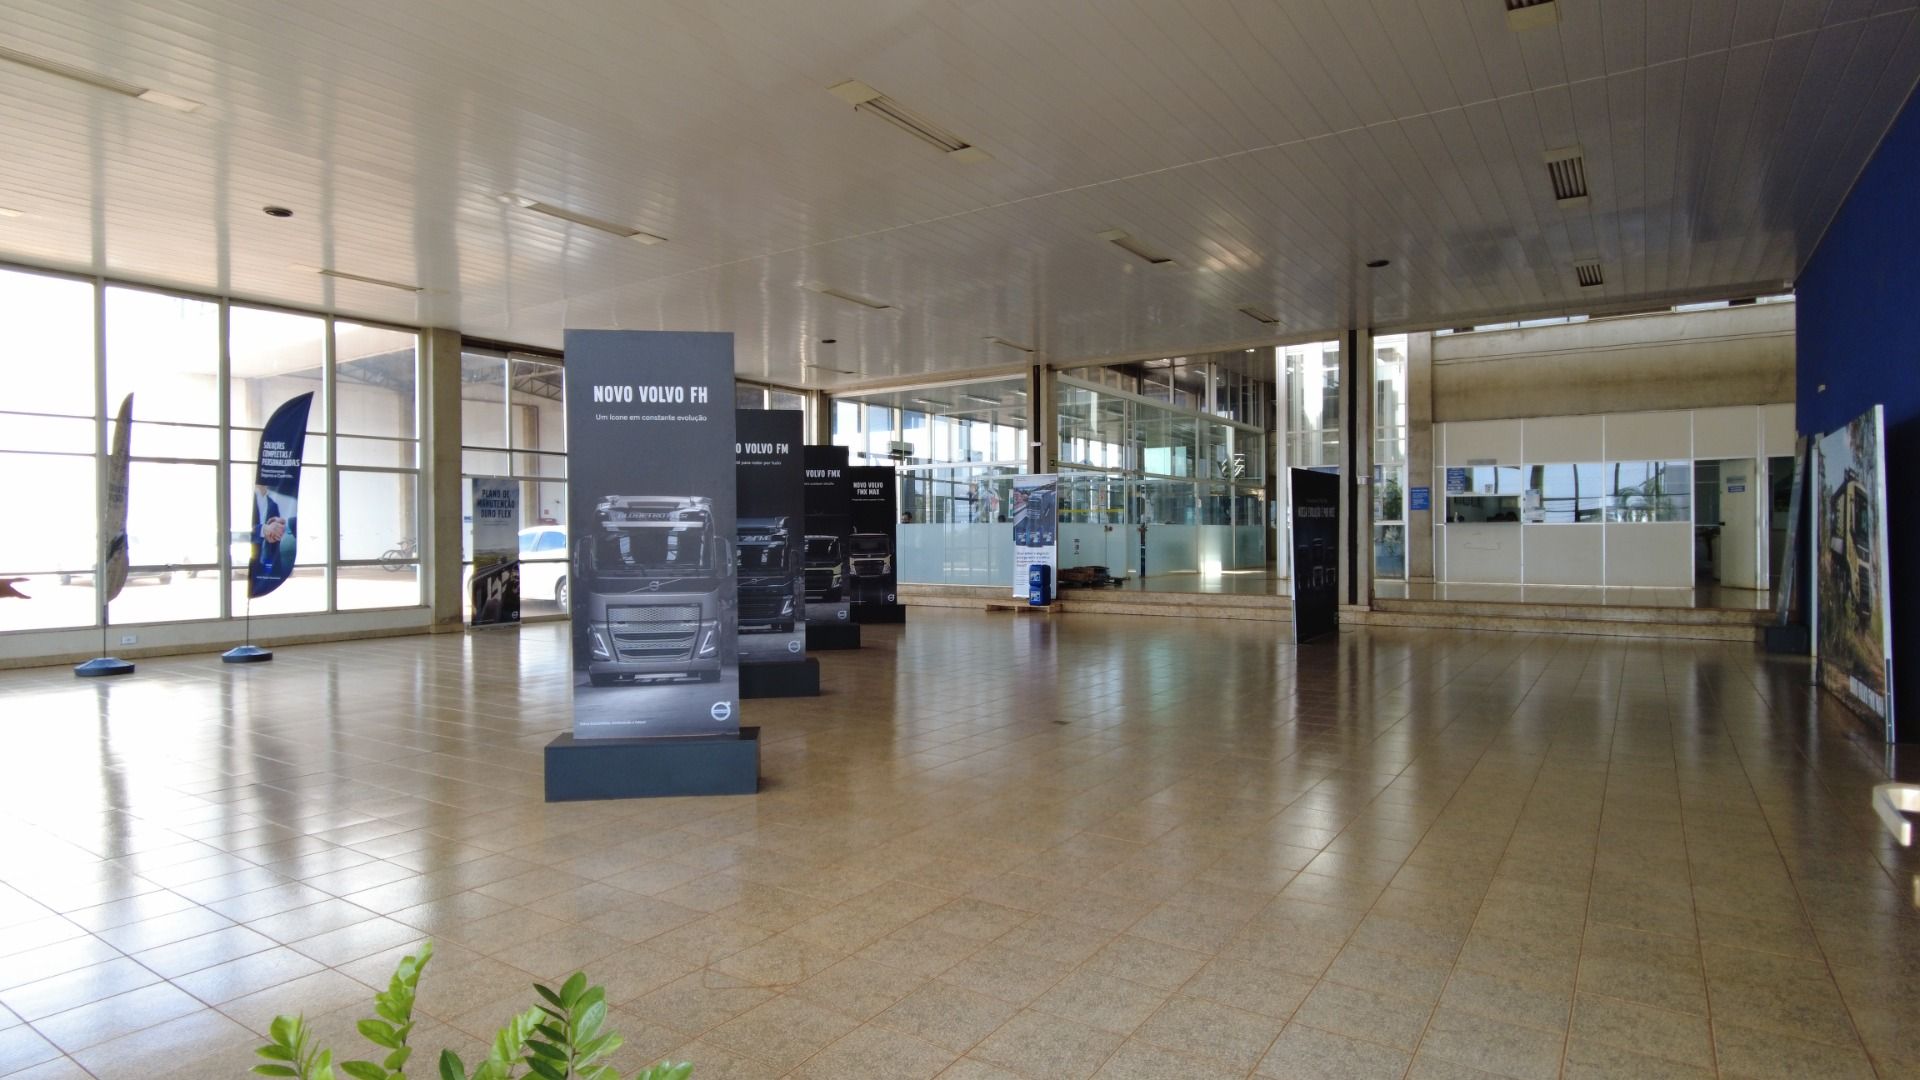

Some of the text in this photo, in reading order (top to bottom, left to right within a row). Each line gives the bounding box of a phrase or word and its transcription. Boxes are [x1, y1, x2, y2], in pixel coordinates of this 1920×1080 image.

[593, 385, 708, 403] NOVO VOLVO FH
[595, 413, 608, 421] Um
[641, 414, 676, 422] constante
[676, 414, 708, 423] evolução
[745, 443, 773, 454] VOLVO
[776, 443, 789, 454] FM
[262, 450, 288, 458] COMPLETAS
[805, 470, 841, 478] VOLVO FMX
[481, 489, 510, 498] PLANO DE
[476, 498, 515, 509] MANUTENÇÃO
[498, 509, 512, 518] FLEX
